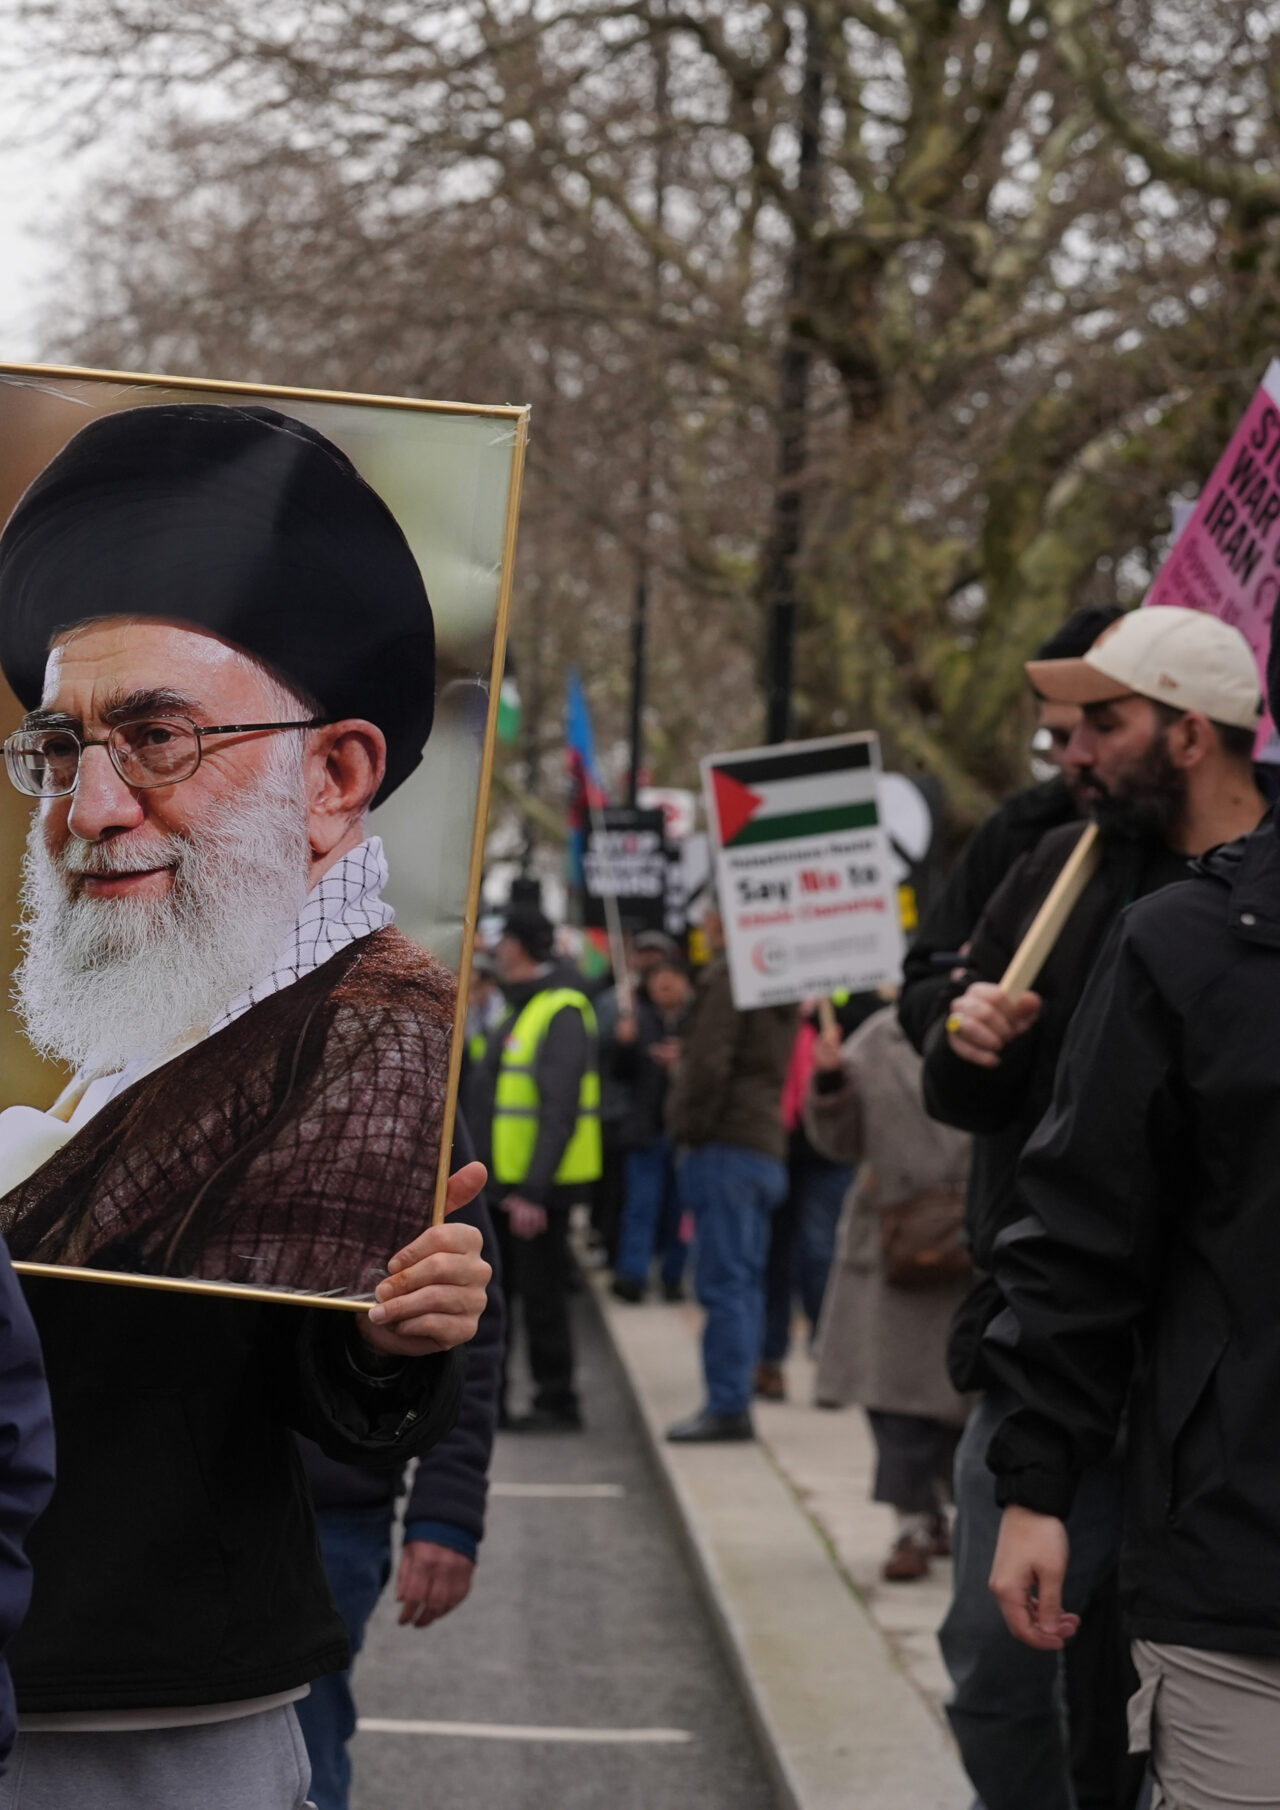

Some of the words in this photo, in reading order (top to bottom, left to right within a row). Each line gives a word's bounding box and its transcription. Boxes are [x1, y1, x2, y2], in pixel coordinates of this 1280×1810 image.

[1202, 488, 1264, 587] IRAN
[737, 876, 791, 905] Say
[798, 868, 844, 893] No
[847, 865, 878, 888] to
